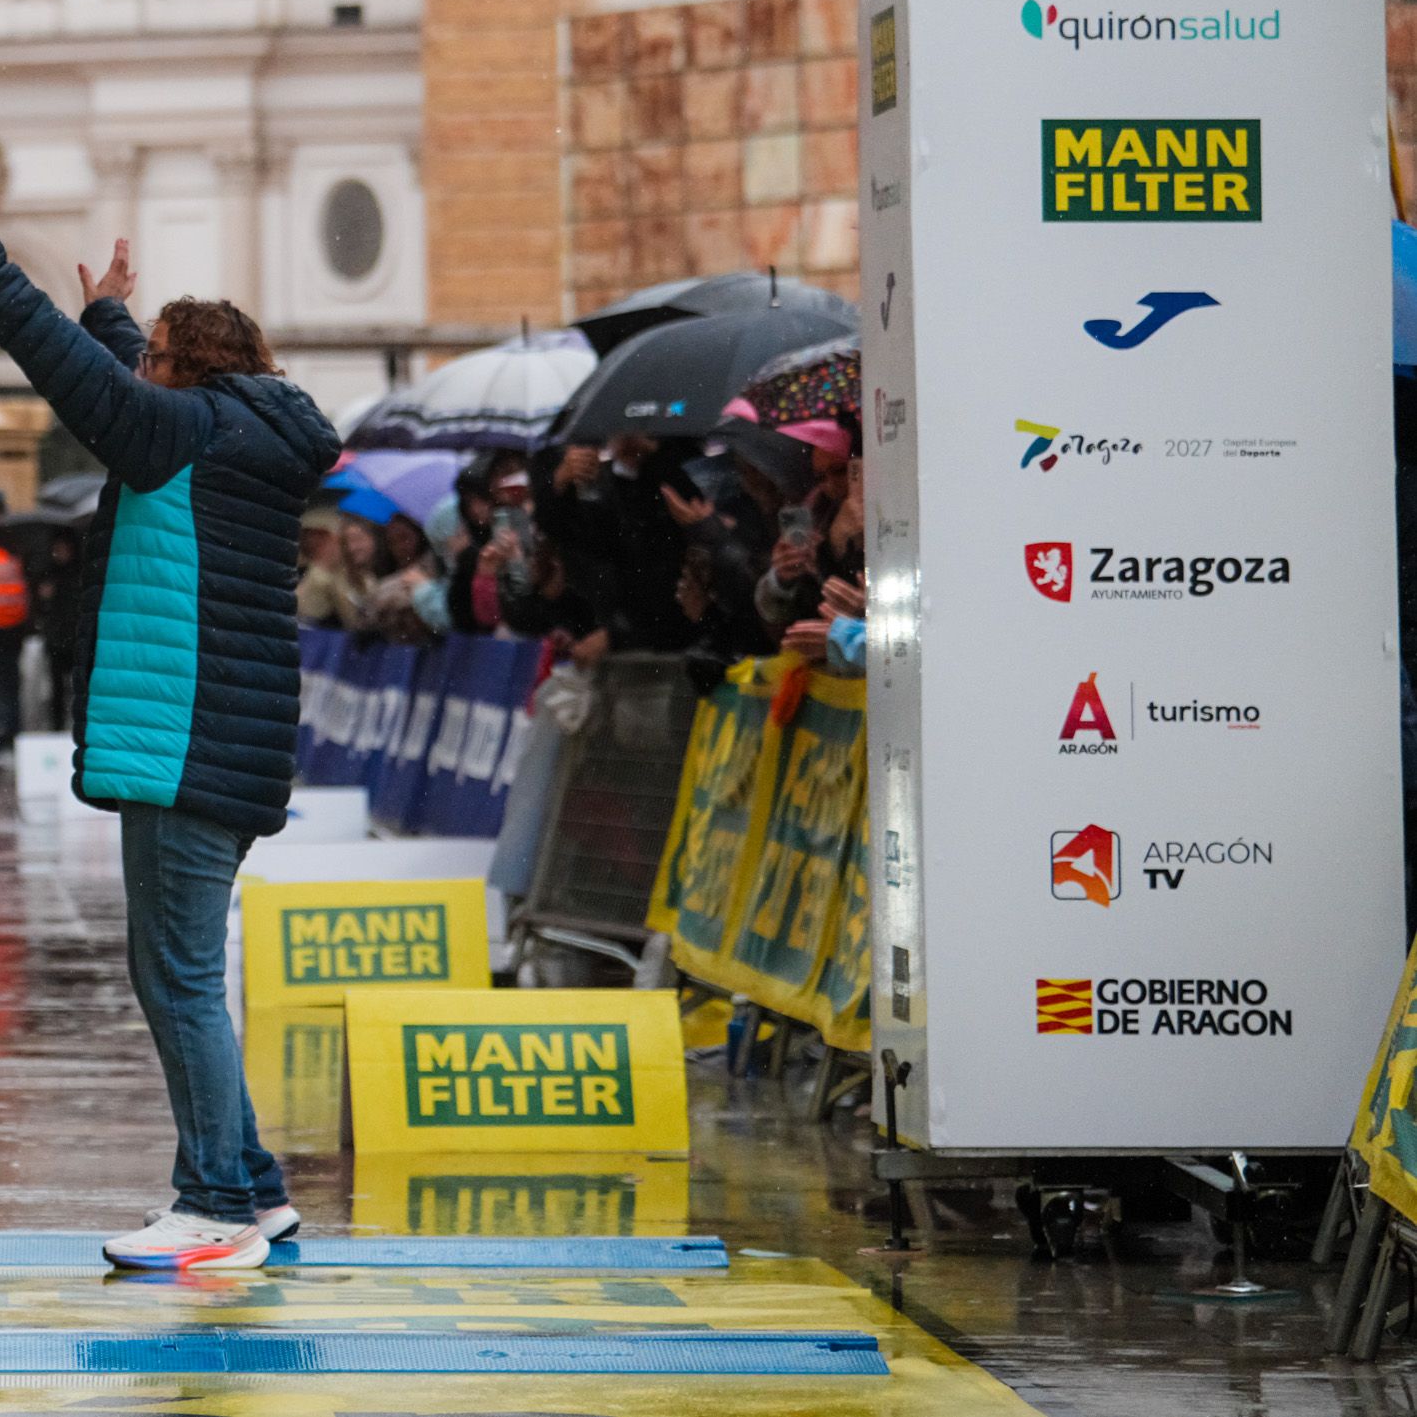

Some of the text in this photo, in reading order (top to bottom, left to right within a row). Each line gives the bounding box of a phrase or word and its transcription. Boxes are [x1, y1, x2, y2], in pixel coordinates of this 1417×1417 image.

[1058, 9, 1281, 51] quirónsalud
[1054, 128, 1250, 168] MANN
[1055, 172, 1251, 213] FILTER
[1164, 438, 1214, 458] 2027
[1089, 548, 1290, 597] Zaragoza
[1090, 589, 1183, 600] AYUNTAMIENTO
[1147, 699, 1260, 723] turismo
[1058, 740, 1118, 755] ARAGÓN
[1143, 837, 1273, 864] ARAGÓN
[1143, 869, 1184, 890] TV
[289, 908, 439, 944] MANN
[291, 945, 443, 980] FILTER
[1096, 978, 1268, 1006] GOBIERNO
[1097, 1009, 1293, 1036] DE ARAGON
[416, 1033, 619, 1072] MANN
[418, 1075, 623, 1116] FILTER
